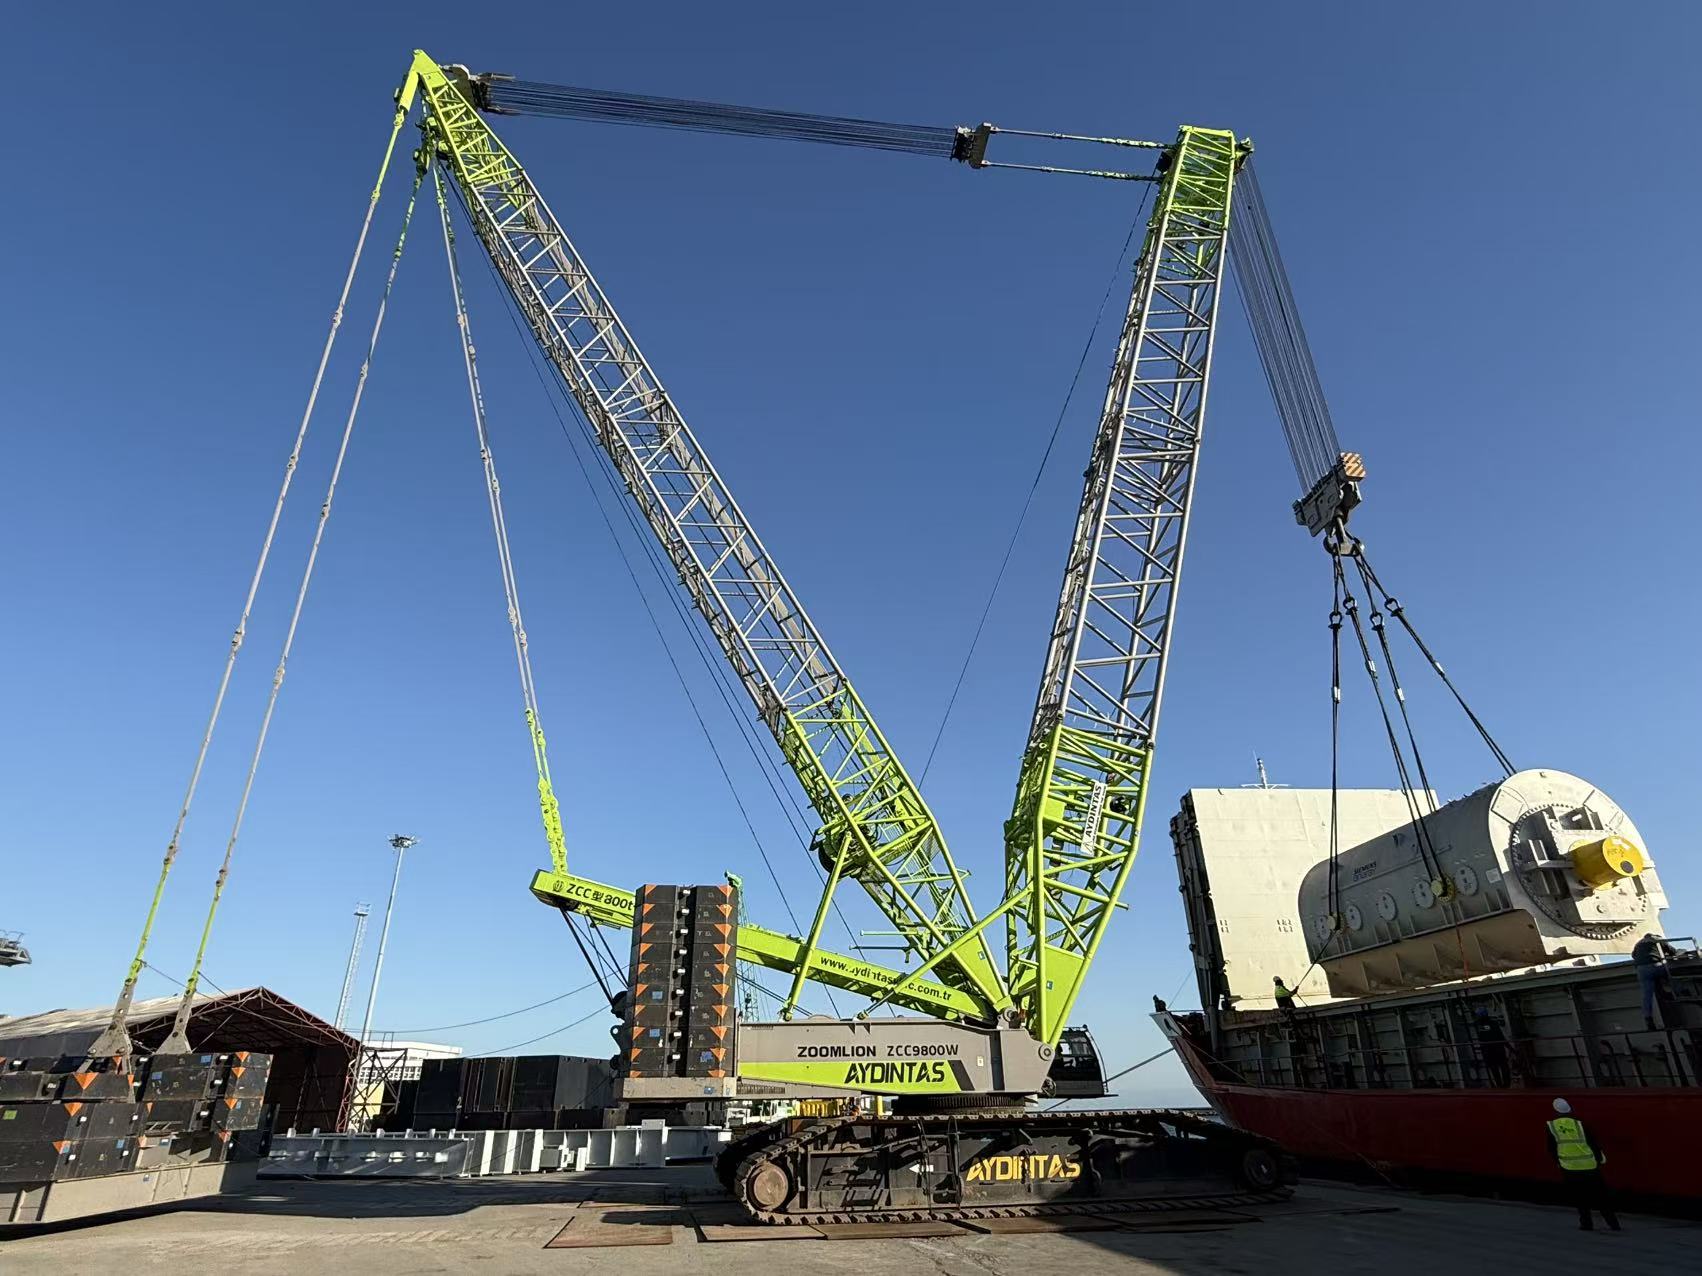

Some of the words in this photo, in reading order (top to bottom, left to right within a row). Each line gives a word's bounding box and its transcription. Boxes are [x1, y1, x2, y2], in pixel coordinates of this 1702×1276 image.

[1085, 785, 1102, 837] AYDINTAS
[797, 1045, 876, 1058] ZOOMLION
[887, 1044, 959, 1056] ZCC9800W
[844, 1061, 945, 1084] AYDINTAS
[966, 1154, 1081, 1181] AYDINTAS
